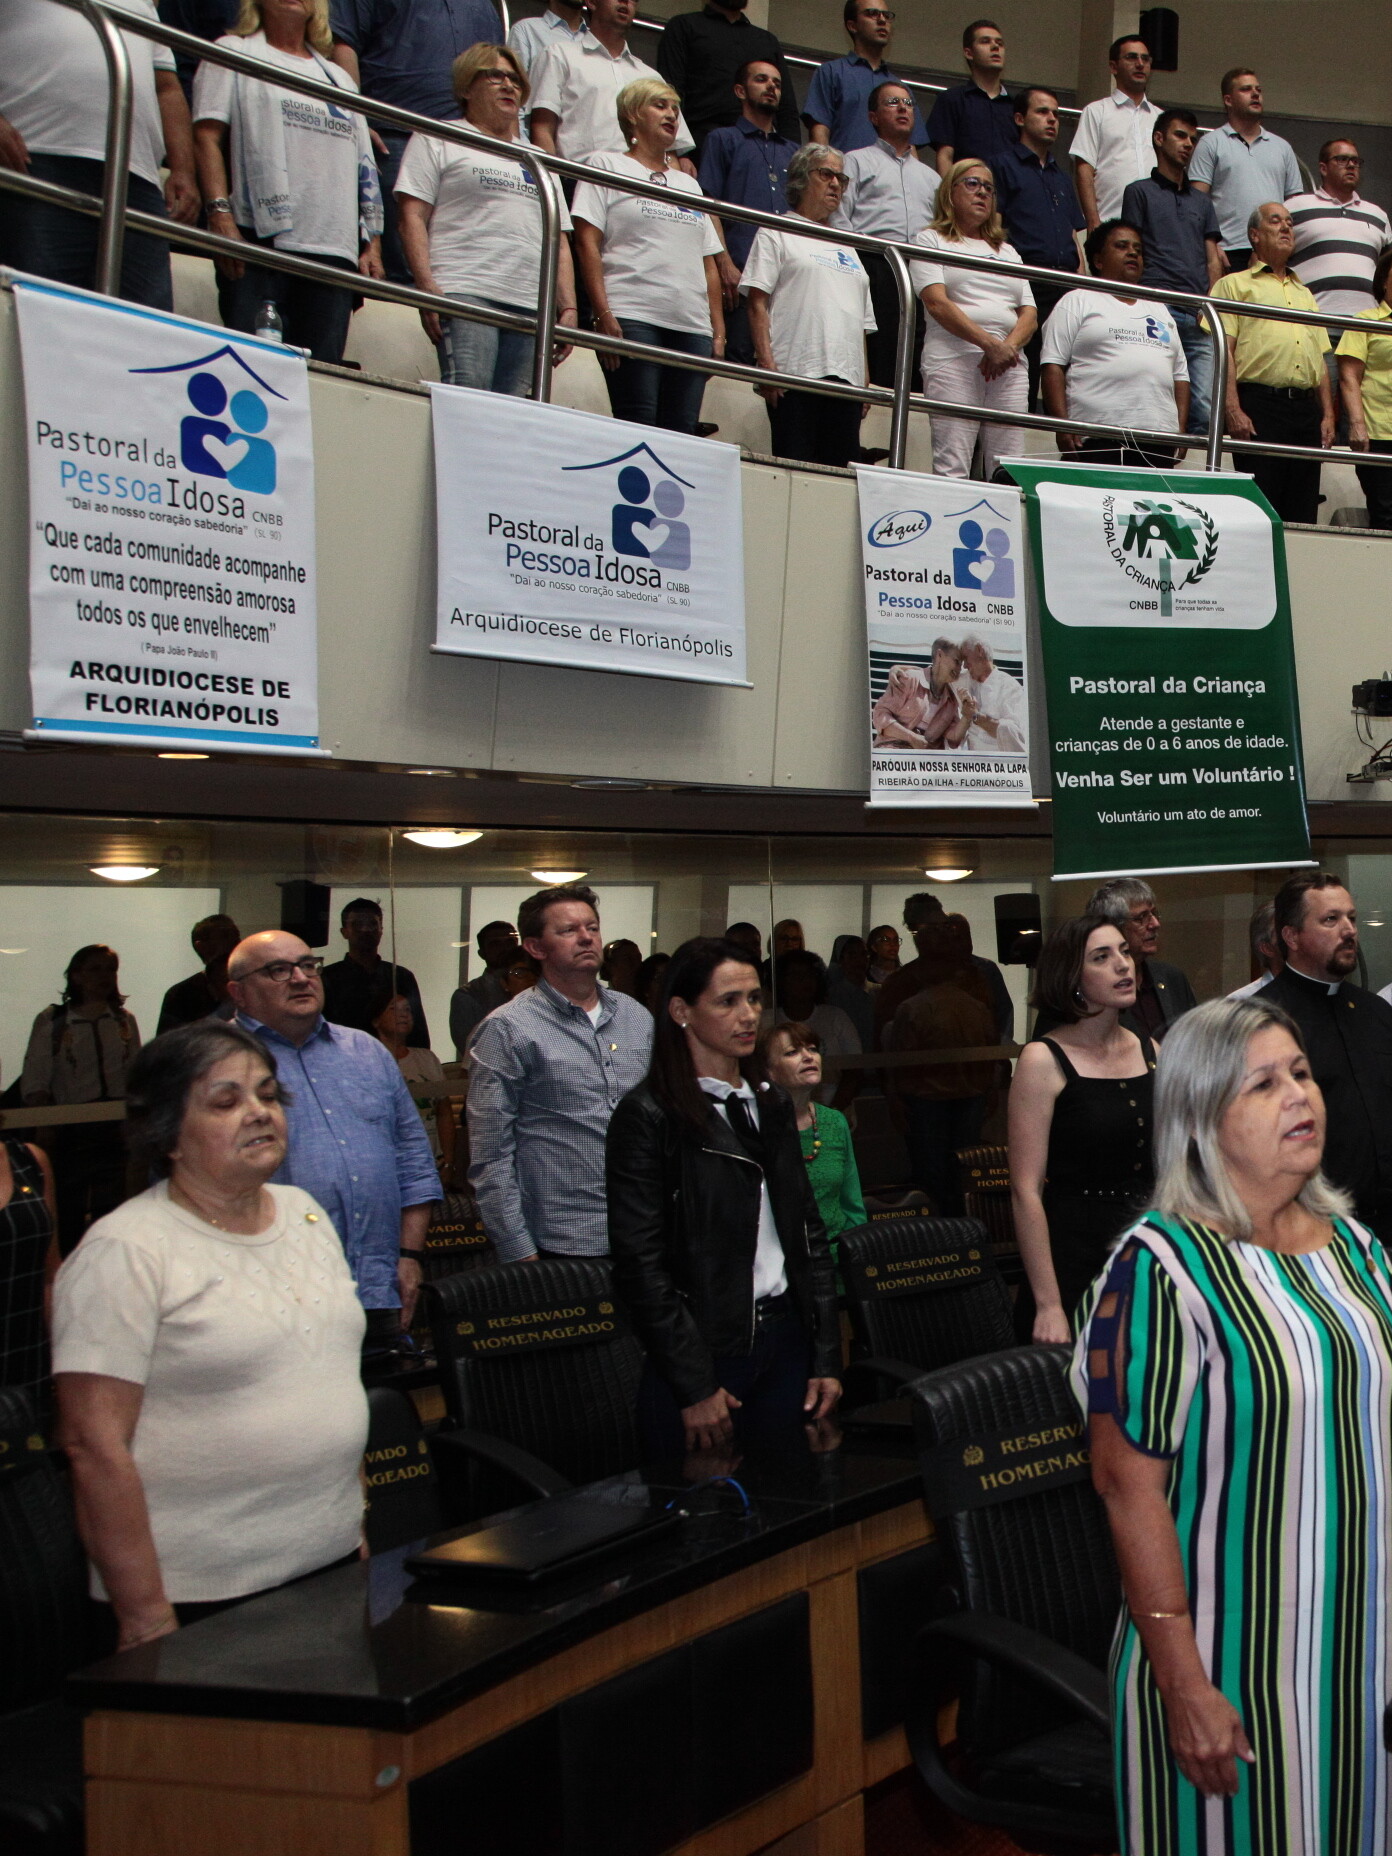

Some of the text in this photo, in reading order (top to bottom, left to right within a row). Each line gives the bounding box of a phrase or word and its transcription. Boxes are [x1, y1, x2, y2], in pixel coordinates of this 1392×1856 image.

[324, 117, 353, 134] Idosa
[472, 167, 510, 179] Pastoral
[480, 175, 515, 189] Pessoa
[516, 181, 539, 196] Idos
[641, 206, 673, 217] Pessoa
[674, 211, 698, 223] Idosa
[1108, 327, 1138, 336] Pastoral
[1115, 334, 1142, 343] Pessoa
[37, 420, 176, 469] Pastoral da
[60, 460, 283, 527] Pessoa Idosa CNBB
[94, 502, 109, 514] ao
[112, 505, 146, 519] nosso
[149, 511, 192, 528] coração
[488, 513, 604, 551] Pastoral da
[1102, 494, 1176, 595] PASTORAL DA CRIANÇA
[84, 531, 122, 556] cada
[127, 541, 221, 571] comunidade
[225, 556, 306, 584] acompanhe
[506, 543, 690, 594] Pessoa Idosa CNBB
[865, 564, 952, 586] Pastoral da
[50, 564, 296, 614] com uma compreensão amorosa
[534, 578, 546, 588] ao
[549, 581, 576, 592] nosso
[578, 584, 614, 598] coração
[679, 597, 691, 607] 90)
[879, 592, 1014, 616] Pessoa Idosa CNBB
[1129, 600, 1159, 610] CNBB
[1175, 605, 1196, 613] crianças
[77, 599, 123, 625] todos
[127, 610, 146, 628] os
[151, 612, 179, 636] que
[906, 612, 928, 620] nosso
[929, 613, 957, 622] coração
[450, 607, 734, 658] Arquidiocese de Florianópolis
[167, 644, 186, 657] João
[187, 647, 209, 659] Paulo
[70, 660, 291, 699] ARQUIDIOCESE DE
[1069, 675, 1266, 698] Pastoral da Criança
[86, 692, 280, 727] FLORIANÓPOLIS
[1099, 716, 1245, 733] Atende a gestante e
[1055, 734, 1289, 755] crianças de 0 a 6 anos de idade.
[872, 759, 1028, 774] PARÓQUIA NOSSA SENHORA DA LAPA
[1055, 765, 1296, 788] Venha Ser um Voluntário !
[878, 776, 920, 786] RIBEIRÃO
[922, 778, 933, 786] DA
[934, 778, 954, 787] ILHA
[960, 777, 1024, 788] FLORIANÓPOLIS
[1097, 807, 1263, 824] Voluntário um ato de amor.
[872, 1209, 917, 1221] RESERVADO
[886, 1253, 960, 1274] RESERVADO
[876, 1265, 982, 1292] HOMENAGEADO
[486, 1305, 587, 1330] RESERVADO
[471, 1320, 615, 1351] HOMENAGEADO
[1000, 1422, 1084, 1456] RESERV
